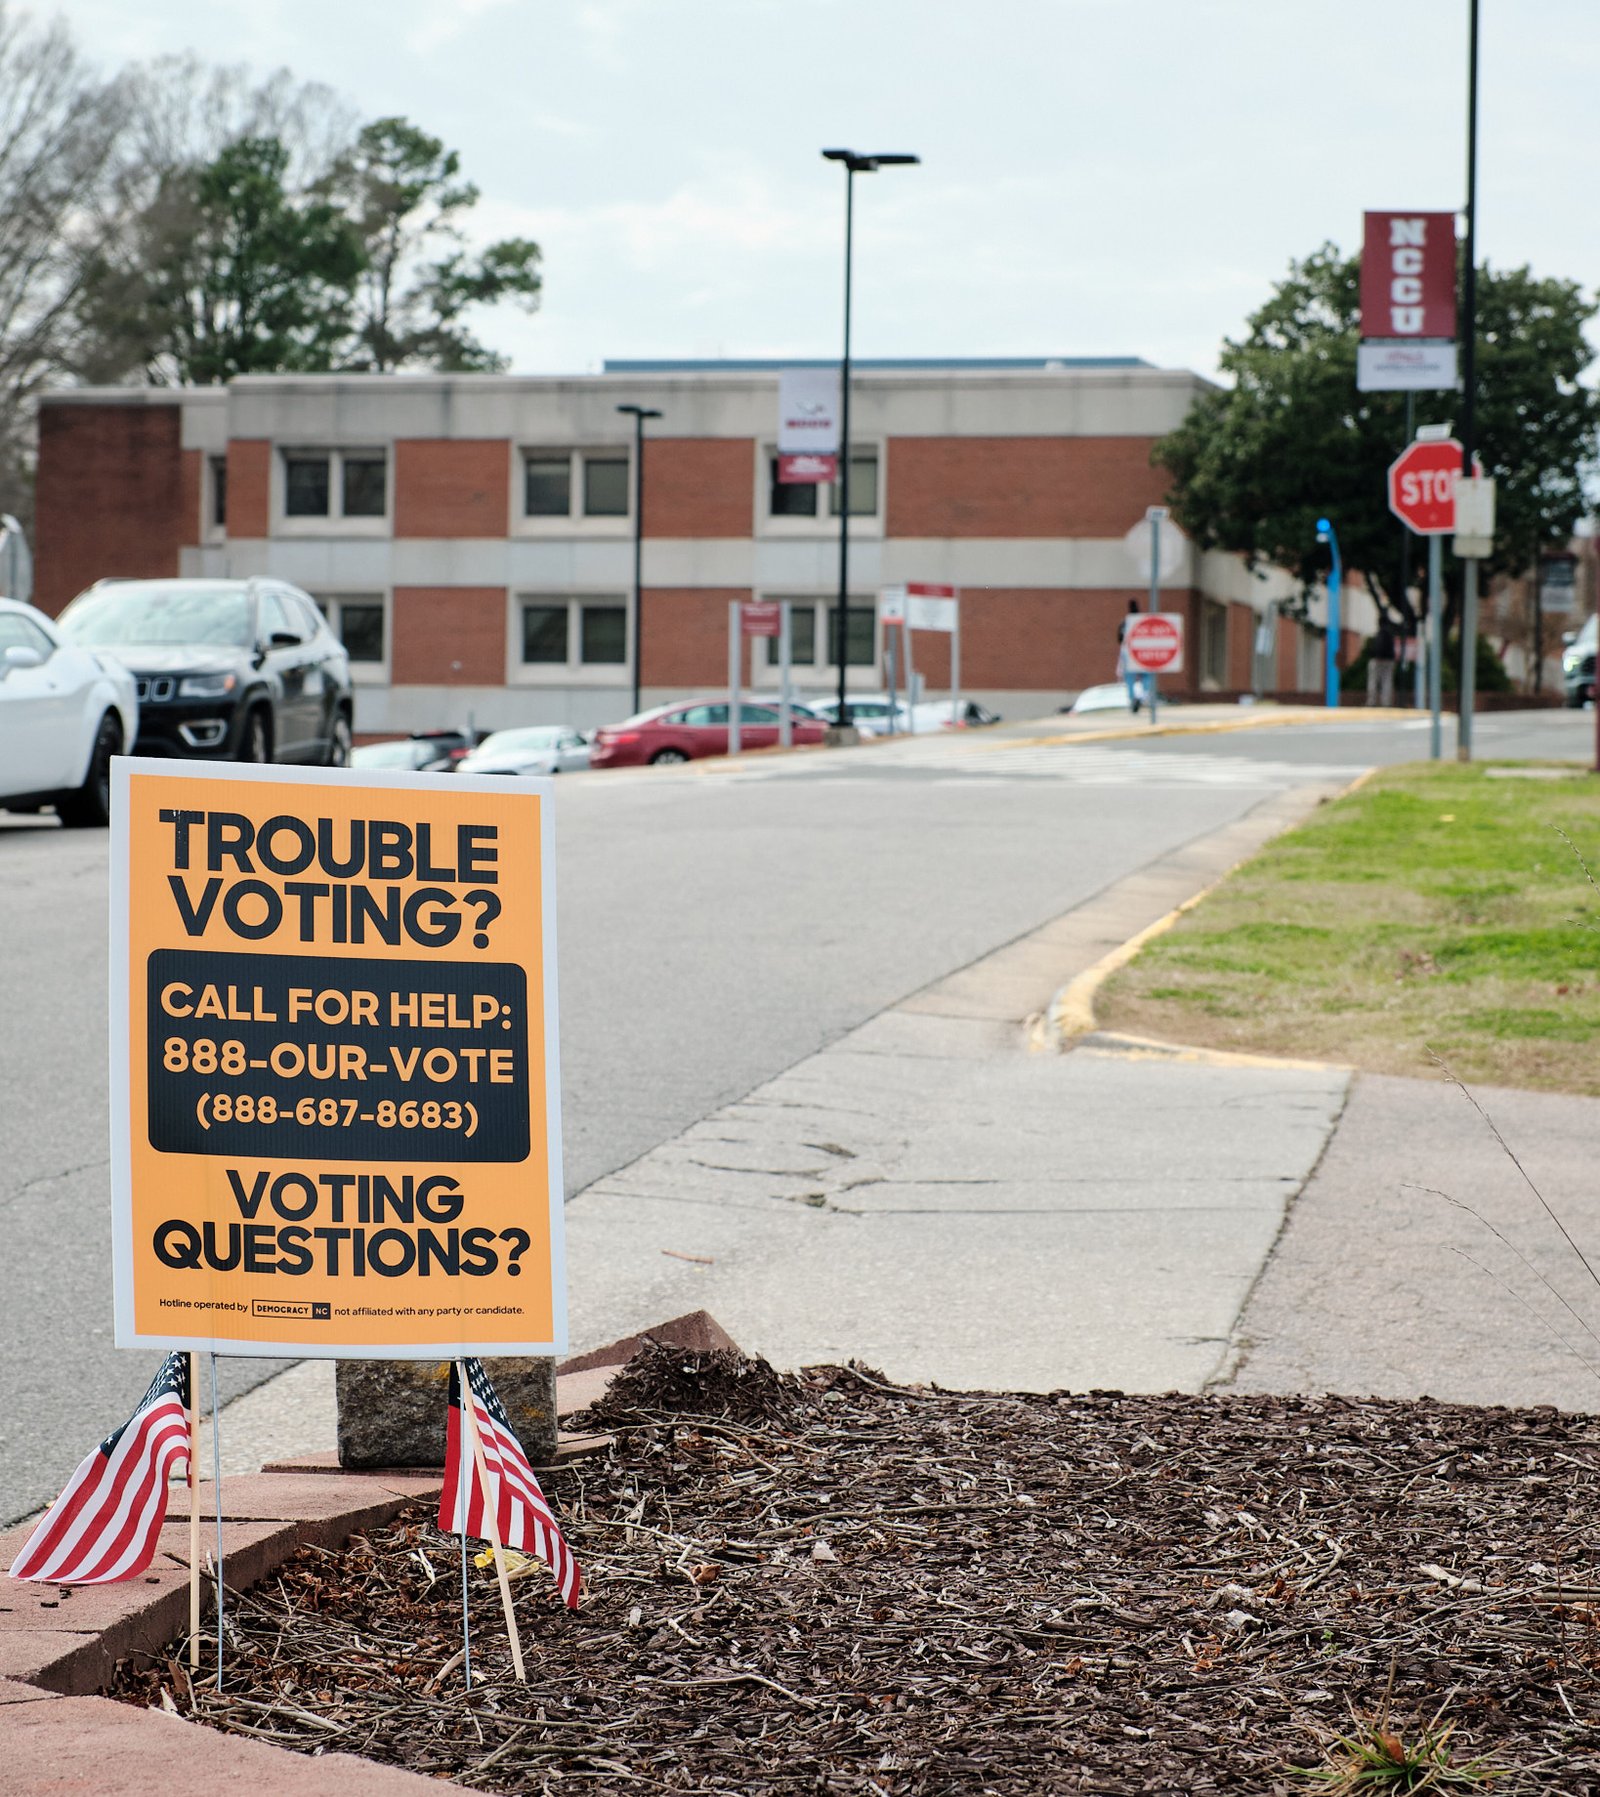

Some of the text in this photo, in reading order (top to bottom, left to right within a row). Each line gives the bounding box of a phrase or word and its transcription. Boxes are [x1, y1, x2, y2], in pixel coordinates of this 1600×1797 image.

[1389, 218, 1427, 334] NCCU
[158, 808, 499, 885] TROUBLE
[166, 874, 502, 950] VOTING?
[160, 981, 513, 1031] CALL FOR HELP:
[162, 1036, 515, 1085] 888-OUR-VOTE
[195, 1091, 480, 1139] (888-687-8683)
[225, 1168, 465, 1225] VOTING
[152, 1218, 532, 1278] QUESTIONS?
[159, 1298, 525, 1317] Hotline operated by DEMOCRACY NC not affiliated with any party or candidate.
